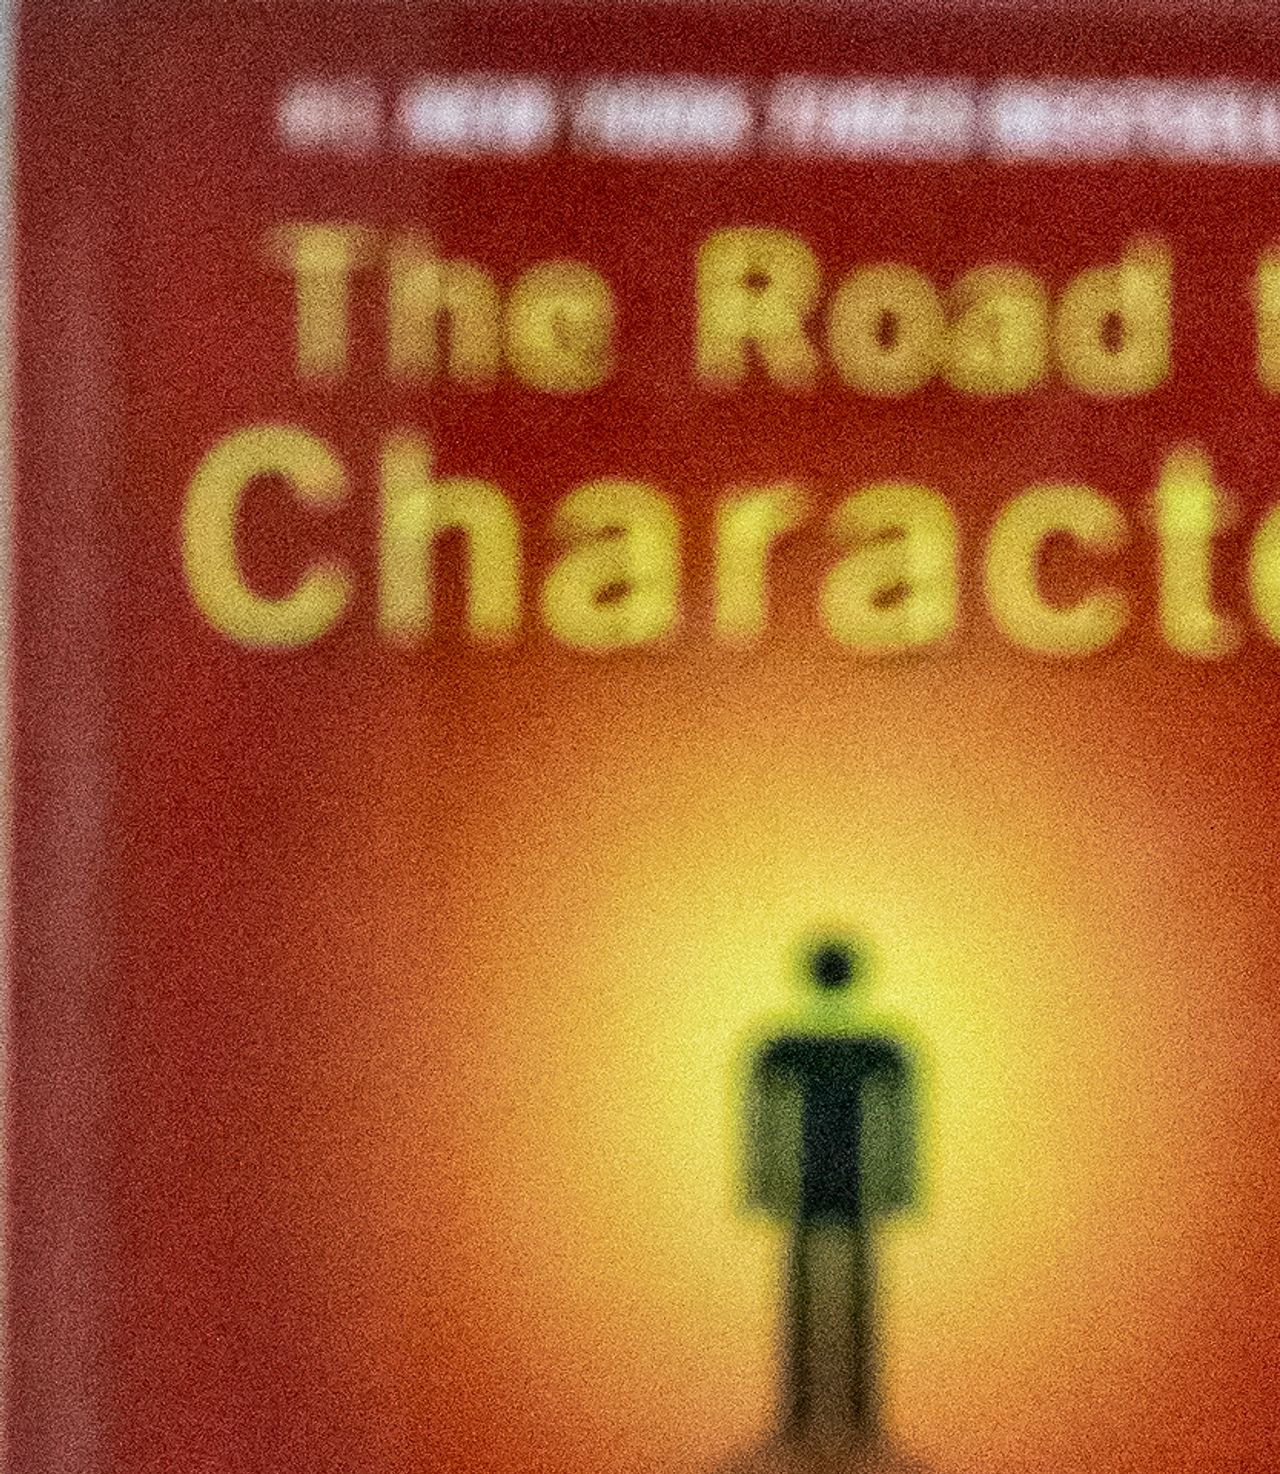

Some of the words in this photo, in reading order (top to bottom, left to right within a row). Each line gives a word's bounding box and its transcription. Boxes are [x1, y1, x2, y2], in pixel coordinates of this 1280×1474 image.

[402, 73, 560, 160] NEW
[568, 75, 754, 160] YORK
[766, 77, 978, 162] TIMES
[265, 222, 617, 390] The
[692, 225, 1175, 396] Road
